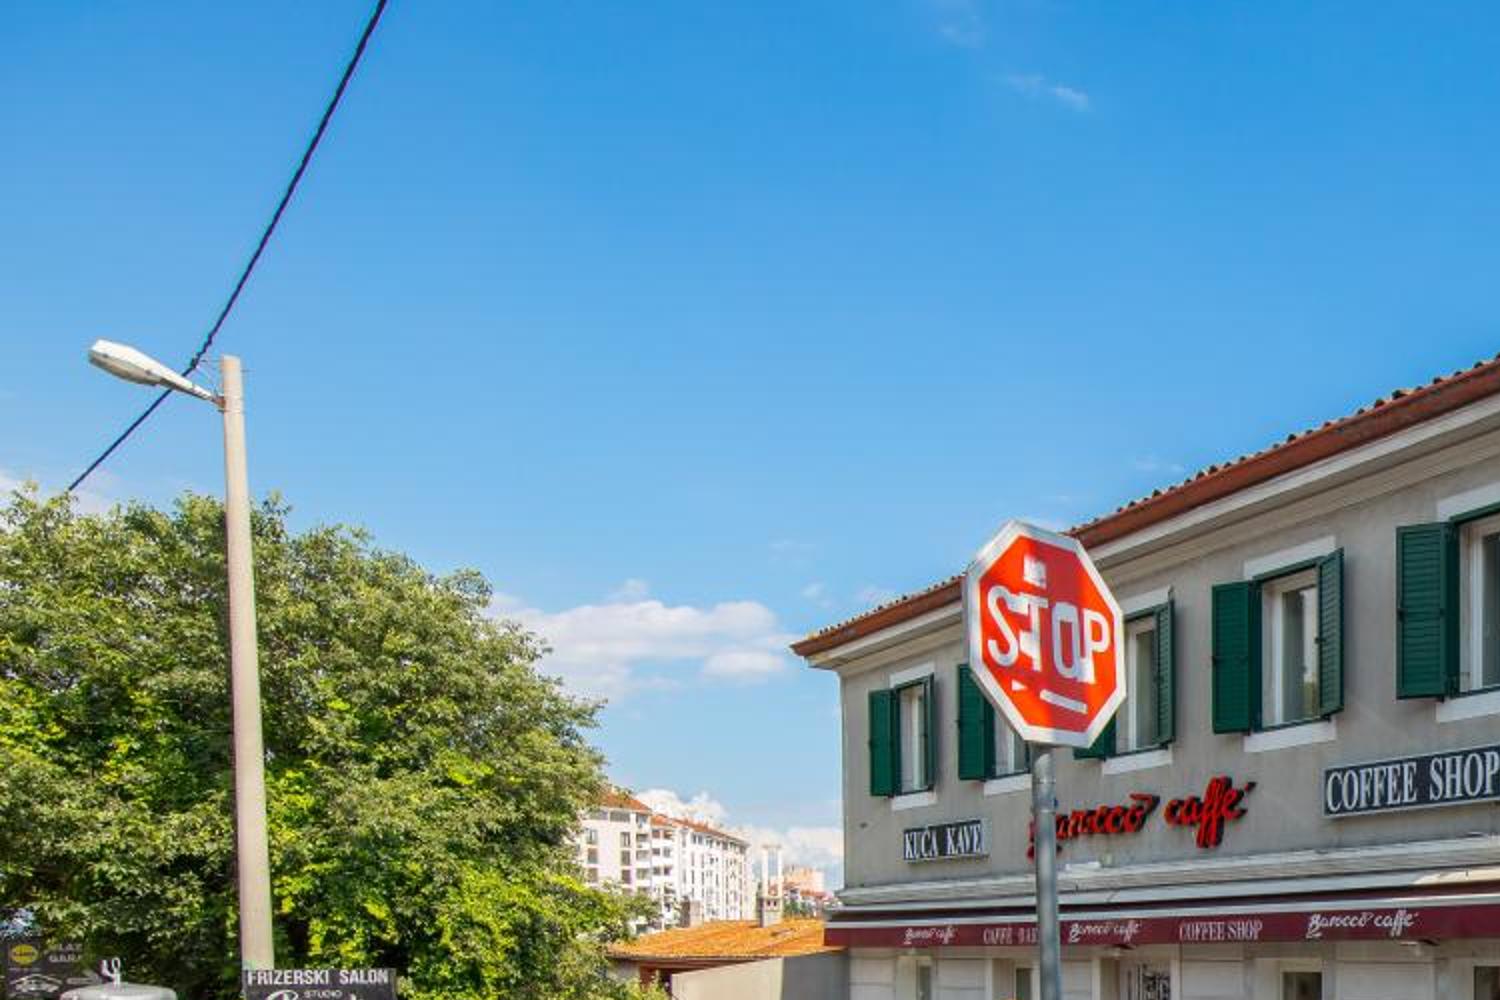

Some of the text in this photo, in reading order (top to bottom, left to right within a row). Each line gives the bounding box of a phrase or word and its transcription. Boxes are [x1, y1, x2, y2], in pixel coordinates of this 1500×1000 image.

[986, 585, 1112, 685] STOP
[1326, 751, 1500, 812] COFFEE SHOP
[945, 823, 982, 856] KAVE
[1179, 919, 1263, 942] COFFEE SHOP
[246, 968, 389, 986] FRIZERSKI SALON
[303, 990, 343, 999] STUDIO
